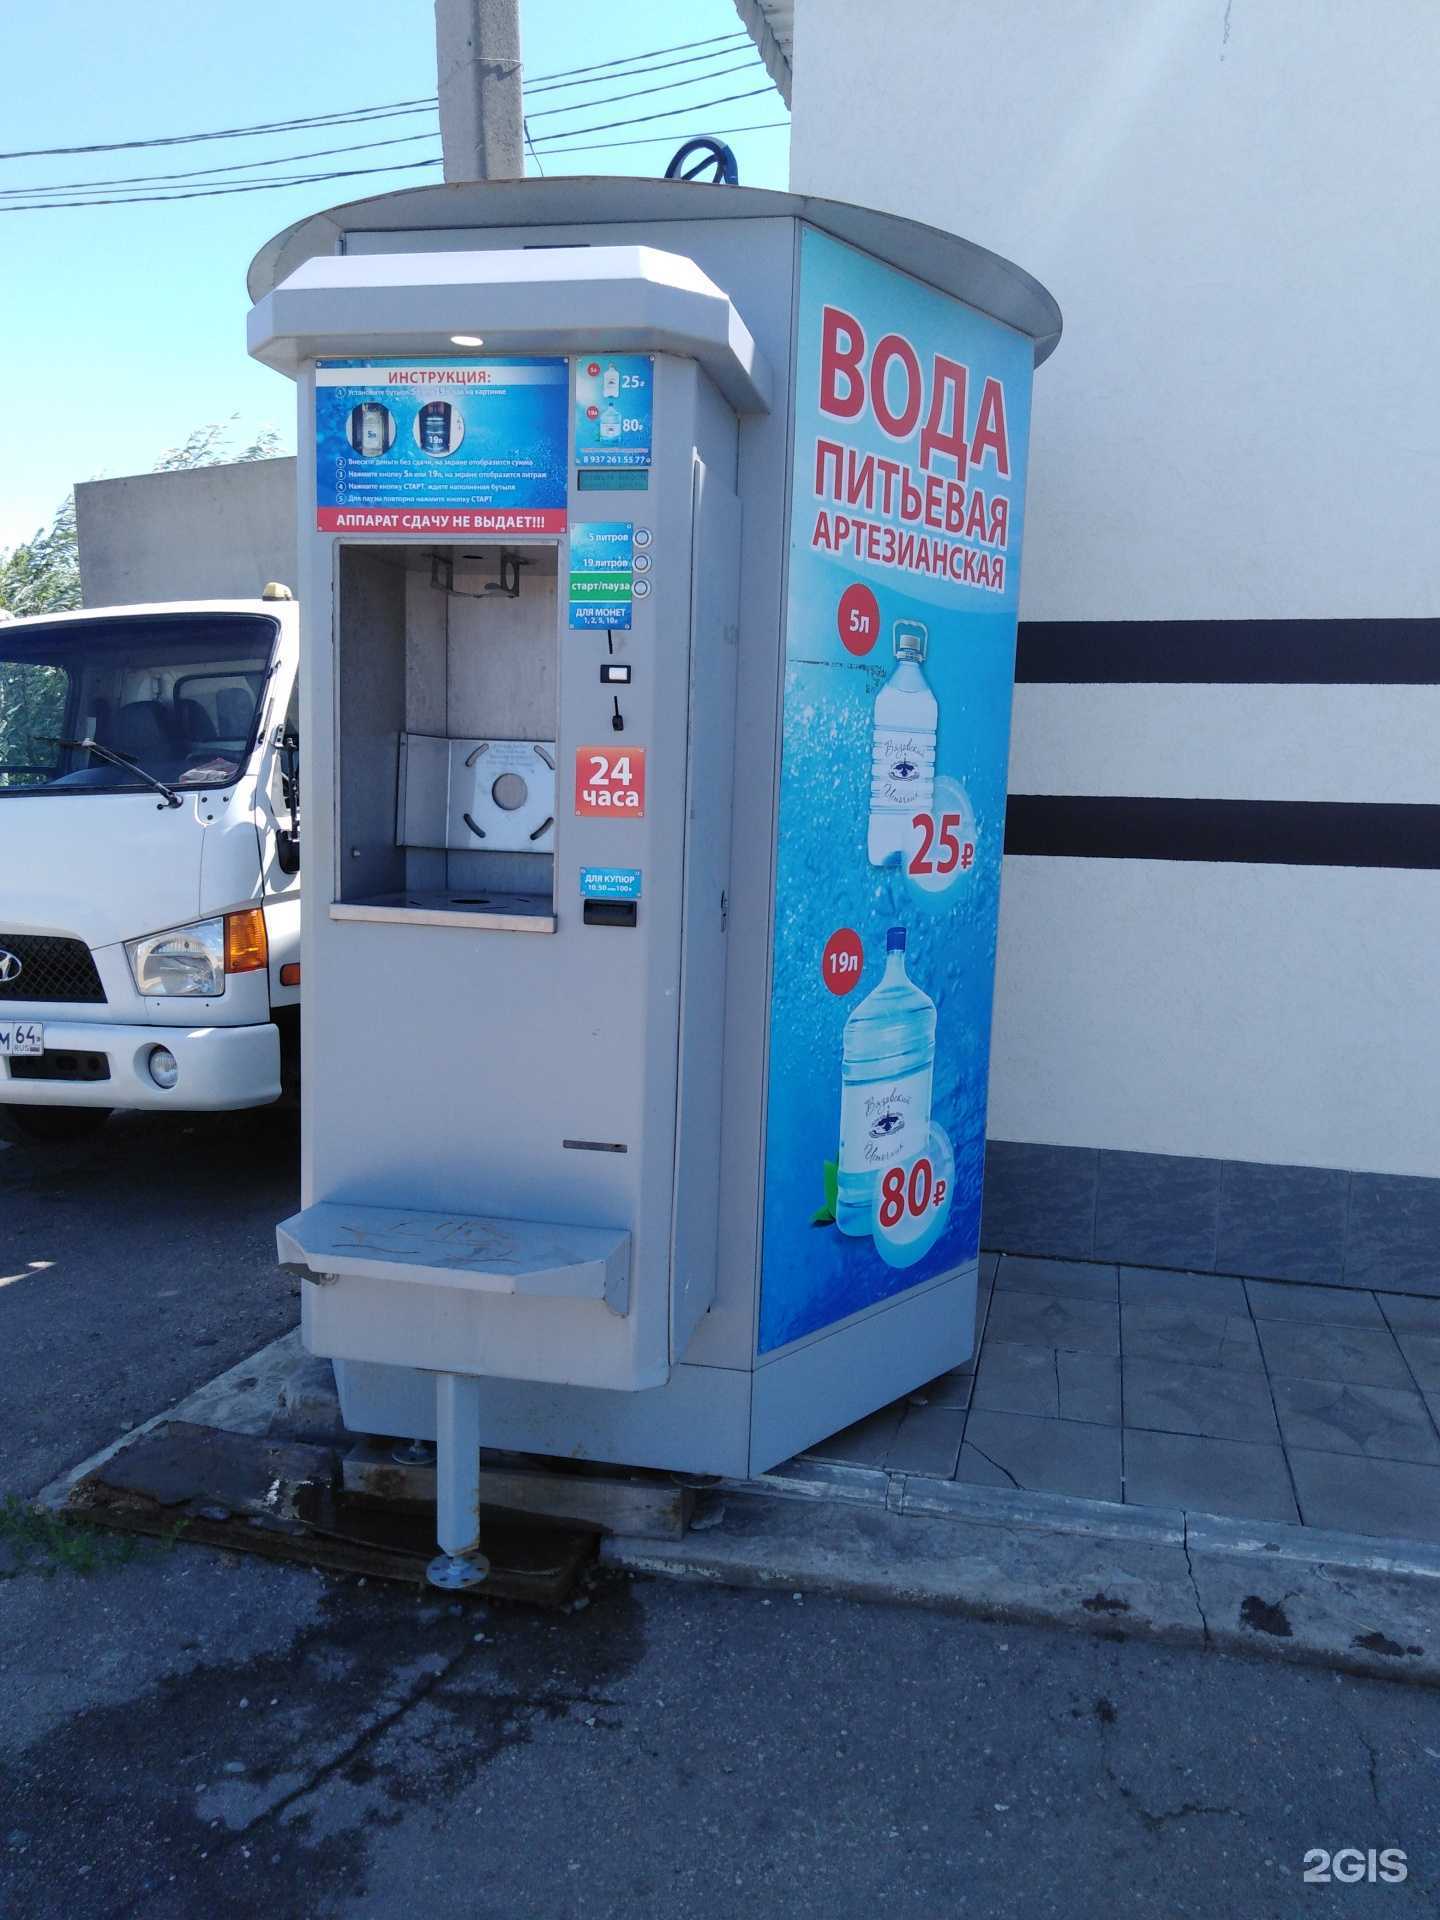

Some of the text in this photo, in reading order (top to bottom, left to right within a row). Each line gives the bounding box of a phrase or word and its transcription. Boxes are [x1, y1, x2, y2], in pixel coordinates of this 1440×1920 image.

[388, 371, 492, 385] ИНСТРУКЦИЯ:
[819, 304, 1011, 482] ВОДА
[815, 438, 1009, 548] ПИТЬЕВАЯ
[336, 514, 545, 531] АППАРАТ СДАЧУ НЕ ВЫДАЕТ!!!
[812, 511, 1004, 590] АРТЕЗИАНСКАЯ
[583, 559, 594, 567] 19
[571, 582, 630, 592] старт/пауза
[576, 608, 625, 618] ДЛЯ МОНЕТ
[849, 608, 870, 634] 5л
[589, 756, 632, 786] 24
[583, 789, 639, 807] часа
[829, 951, 858, 974] 19л
[15, 1025, 35, 1044] 64
